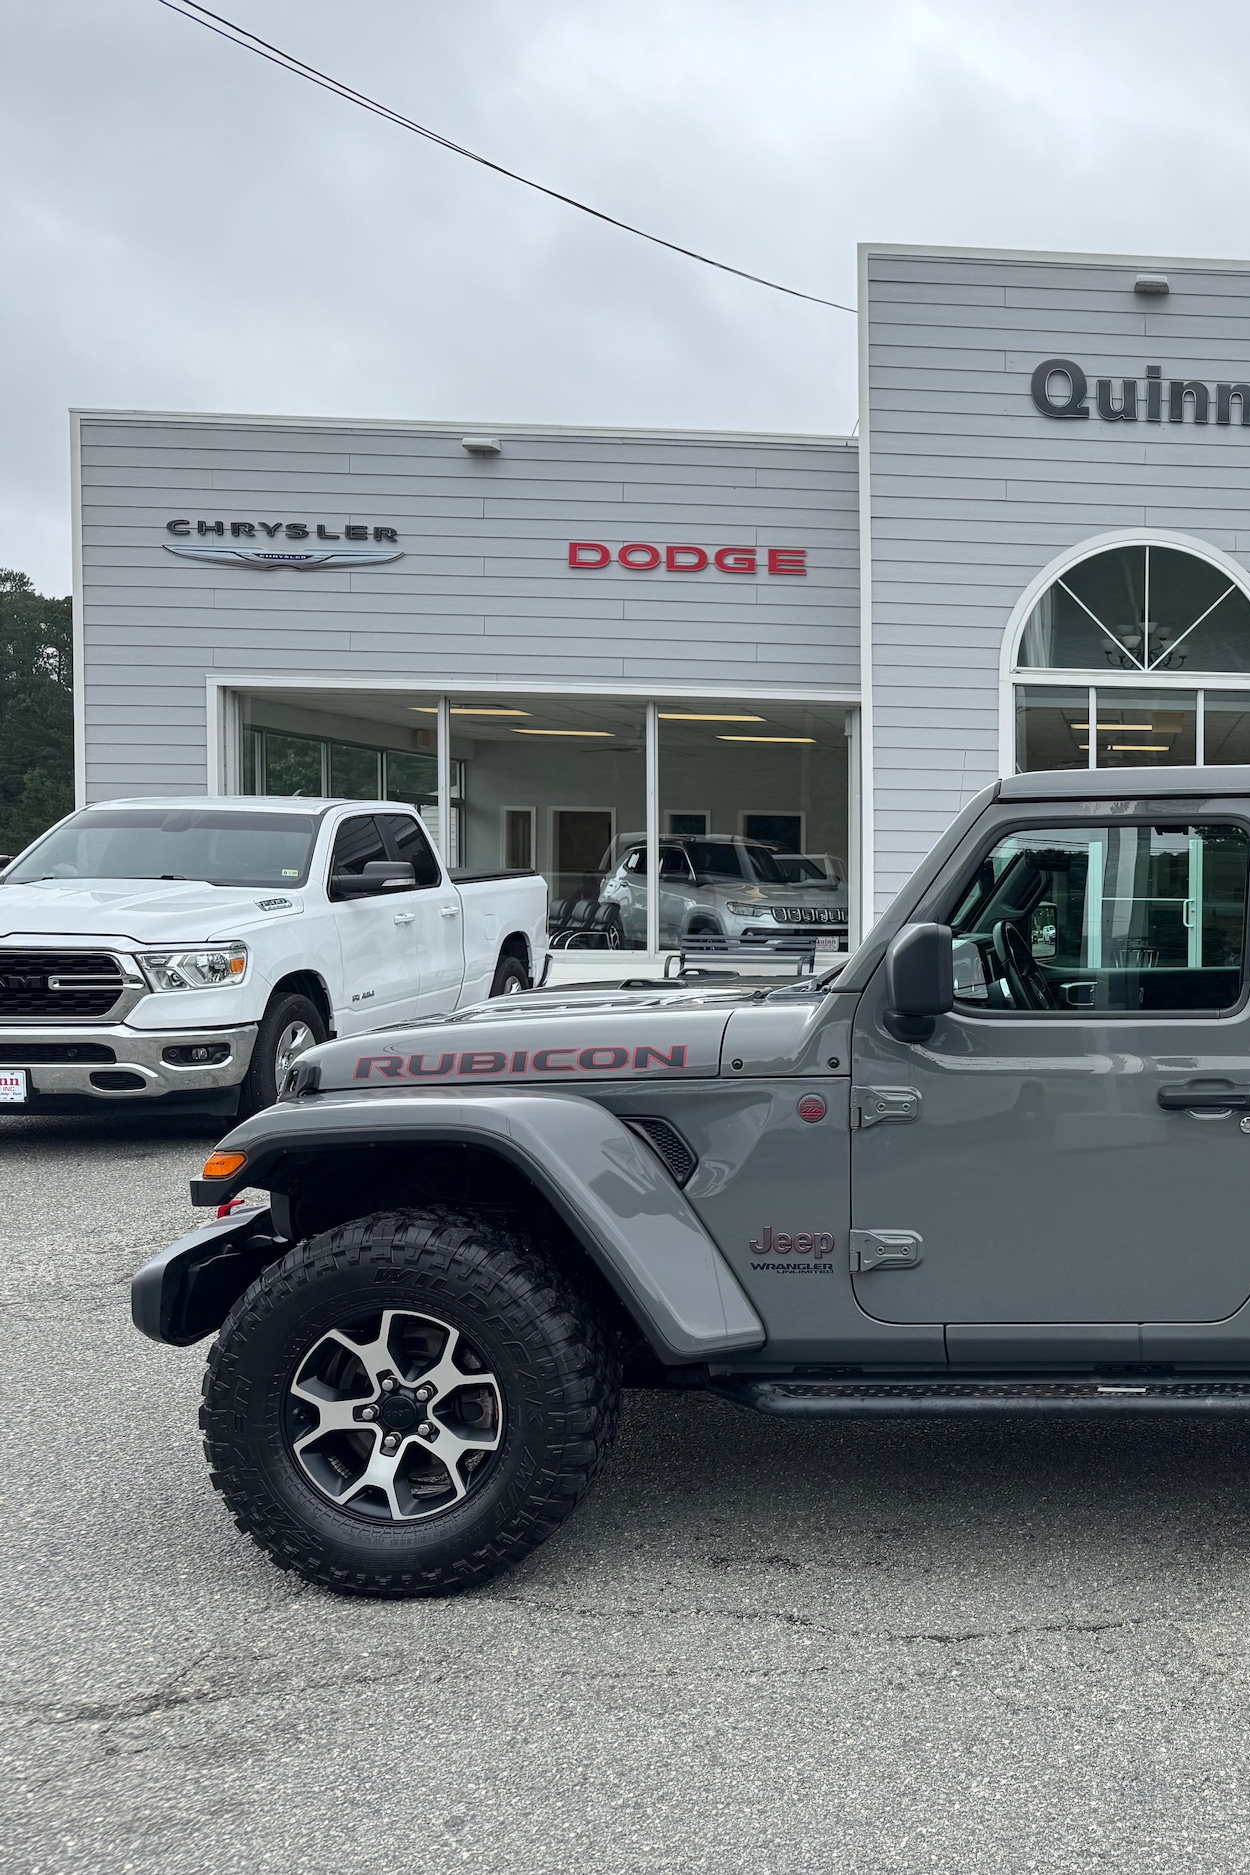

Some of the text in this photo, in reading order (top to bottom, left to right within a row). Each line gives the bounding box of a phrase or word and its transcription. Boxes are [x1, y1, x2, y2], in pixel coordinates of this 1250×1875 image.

[166, 520, 398, 542] CHRYSLER
[568, 542, 807, 576] DODGE
[353, 1044, 689, 1081] RUBICON
[750, 1226, 835, 1259] Jeep
[750, 1262, 834, 1271] WRANGLER
